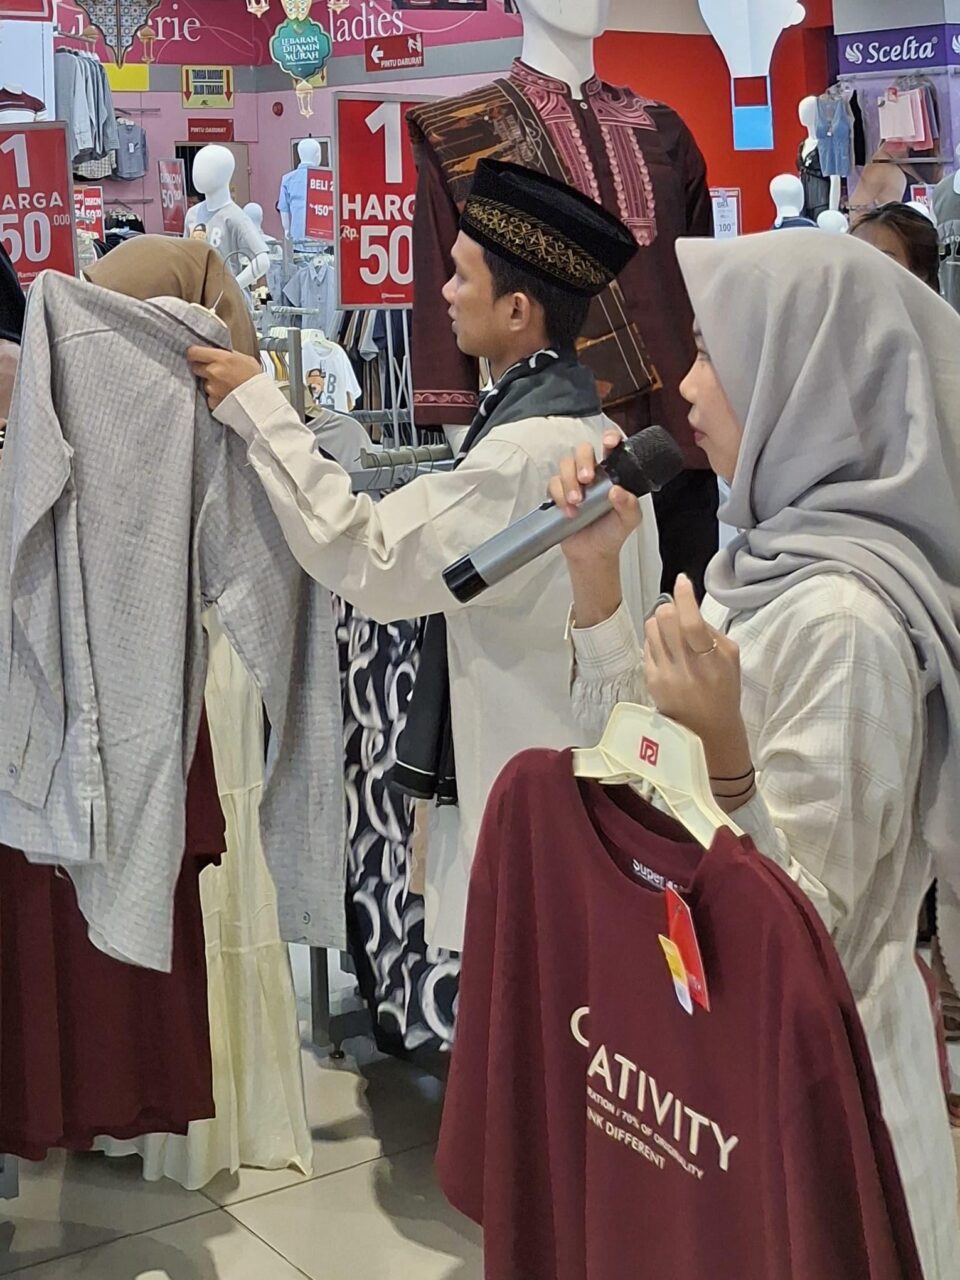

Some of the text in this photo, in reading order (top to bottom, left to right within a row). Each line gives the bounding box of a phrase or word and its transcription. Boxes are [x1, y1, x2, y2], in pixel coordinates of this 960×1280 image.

[327, 0, 404, 43] ladies
[281, 35, 319, 46] LEBARAN
[282, 43, 320, 54] DIJAMIN
[866, 35, 935, 64] Scelta
[284, 51, 319, 62] MURAH
[380, 55, 422, 68] PINTU DARURAT
[365, 101, 403, 184] 1
[0, 133, 31, 188] 1
[310, 178, 328, 191] BELI
[342, 193, 416, 221] HARG
[359, 224, 414, 286] 50
[605, 1121, 667, 1170] DIFFERENT
